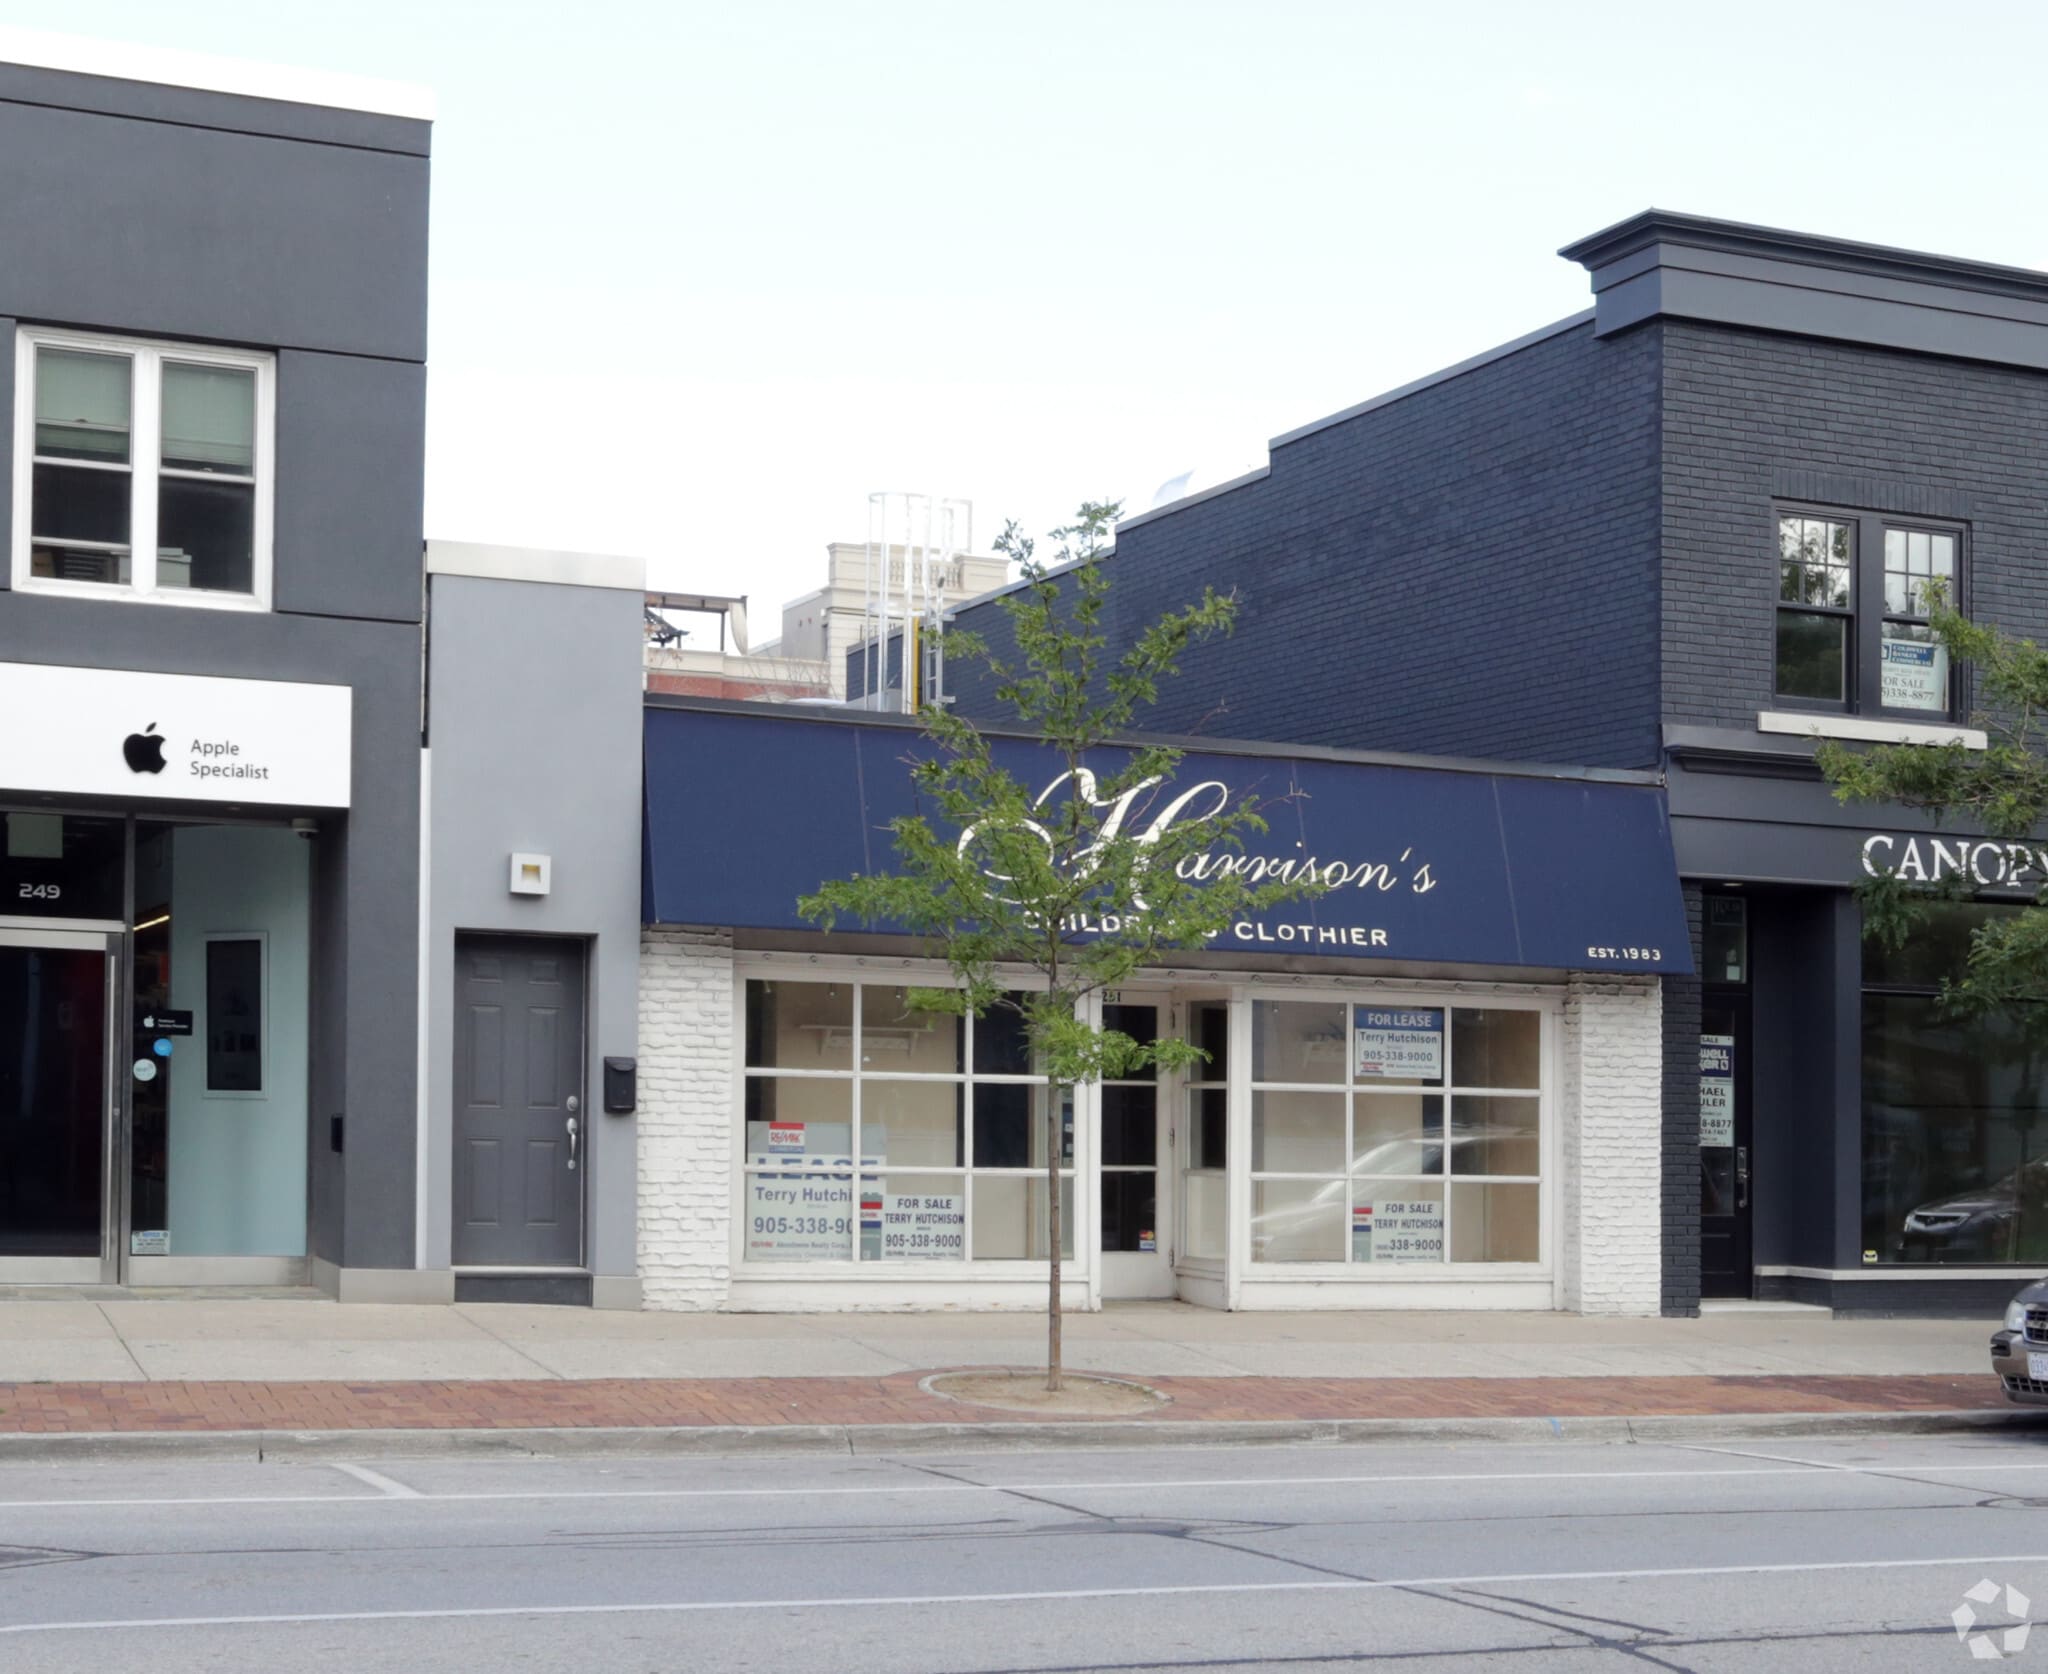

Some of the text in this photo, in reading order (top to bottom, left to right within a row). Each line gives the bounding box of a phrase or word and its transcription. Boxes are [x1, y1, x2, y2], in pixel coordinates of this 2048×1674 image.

[1883, 677, 1898, 687] OR
[190, 739, 239, 757] Apple
[190, 761, 269, 780] Specialist
[19, 883, 61, 899] 249
[1234, 921, 1388, 947] CLOTHIER
[1368, 1013, 1432, 1027] FOR LEASE
[1361, 1032, 1437, 1044] Terry Hutchison
[1363, 1050, 1433, 1061] 905-338-9000
[755, 1186, 853, 1205] Terry Hutchi
[897, 1199, 952, 1210] FOR SALE
[1385, 1203, 1433, 1213] FOR SALE
[754, 1216, 853, 1234] 905-338-90
[885, 1213, 912, 1225] TERRY
[916, 1213, 964, 1225] HUTCHISON
[1374, 1219, 1443, 1229] TERRY HUTCHISON
[885, 1234, 961, 1247] 905-338-9000
[1390, 1239, 1442, 1250] 338-9000
